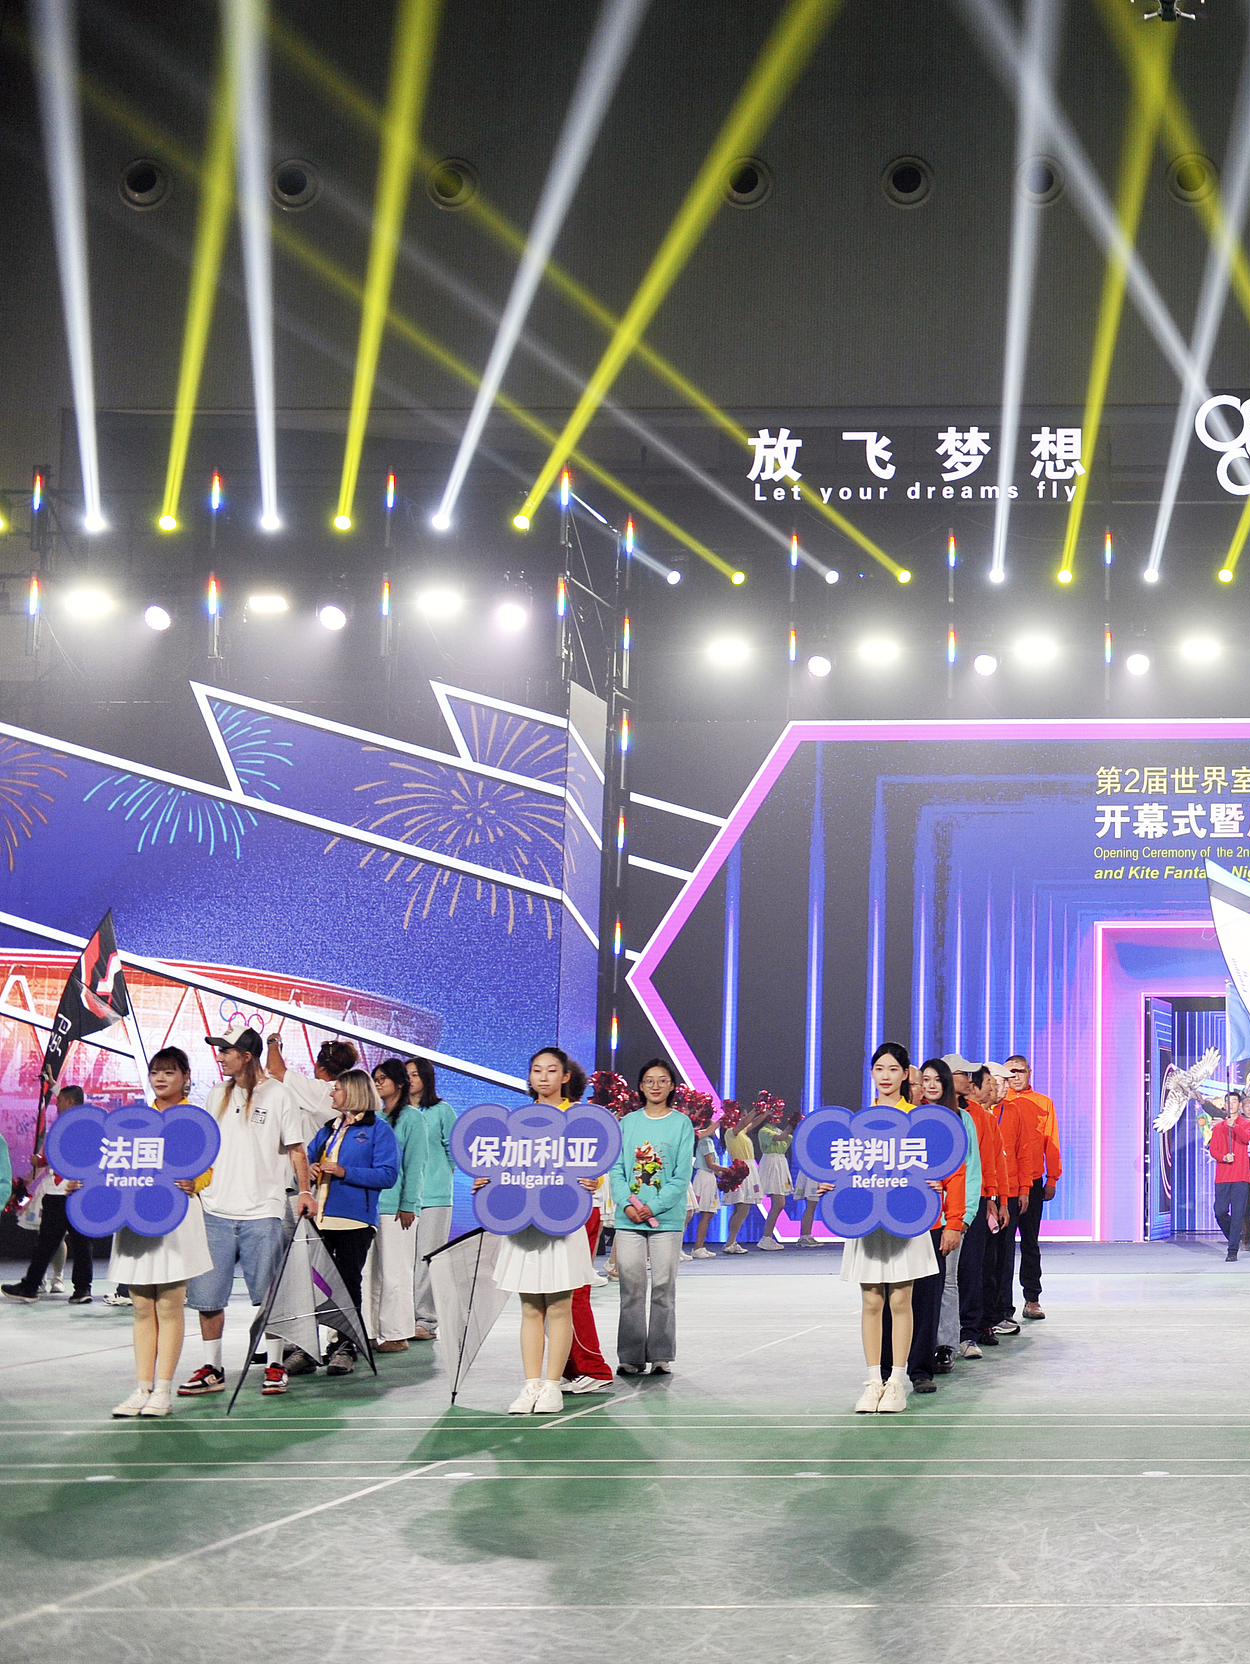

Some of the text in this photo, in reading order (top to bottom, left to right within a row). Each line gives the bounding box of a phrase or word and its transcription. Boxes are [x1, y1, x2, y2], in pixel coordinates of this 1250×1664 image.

[746, 426, 1086, 482] 放飞梦想
[754, 480, 1077, 504] Let your dreams fly
[1094, 846, 1139, 860] Opening
[1142, 846, 1197, 860] Ceremony
[1200, 846, 1211, 858] of
[1216, 846, 1234, 858] the
[1094, 866, 1124, 879] and
[1128, 866, 1160, 879] Kite
[1163, 866, 1220, 880] Fanta
[98, 1136, 165, 1170] 法国
[467, 1135, 598, 1168] 保加利亚
[830, 1137, 929, 1171] 裁判员
[105, 1173, 154, 1187] France
[500, 1171, 564, 1189] Bulgaria
[852, 1173, 908, 1188] Referee
